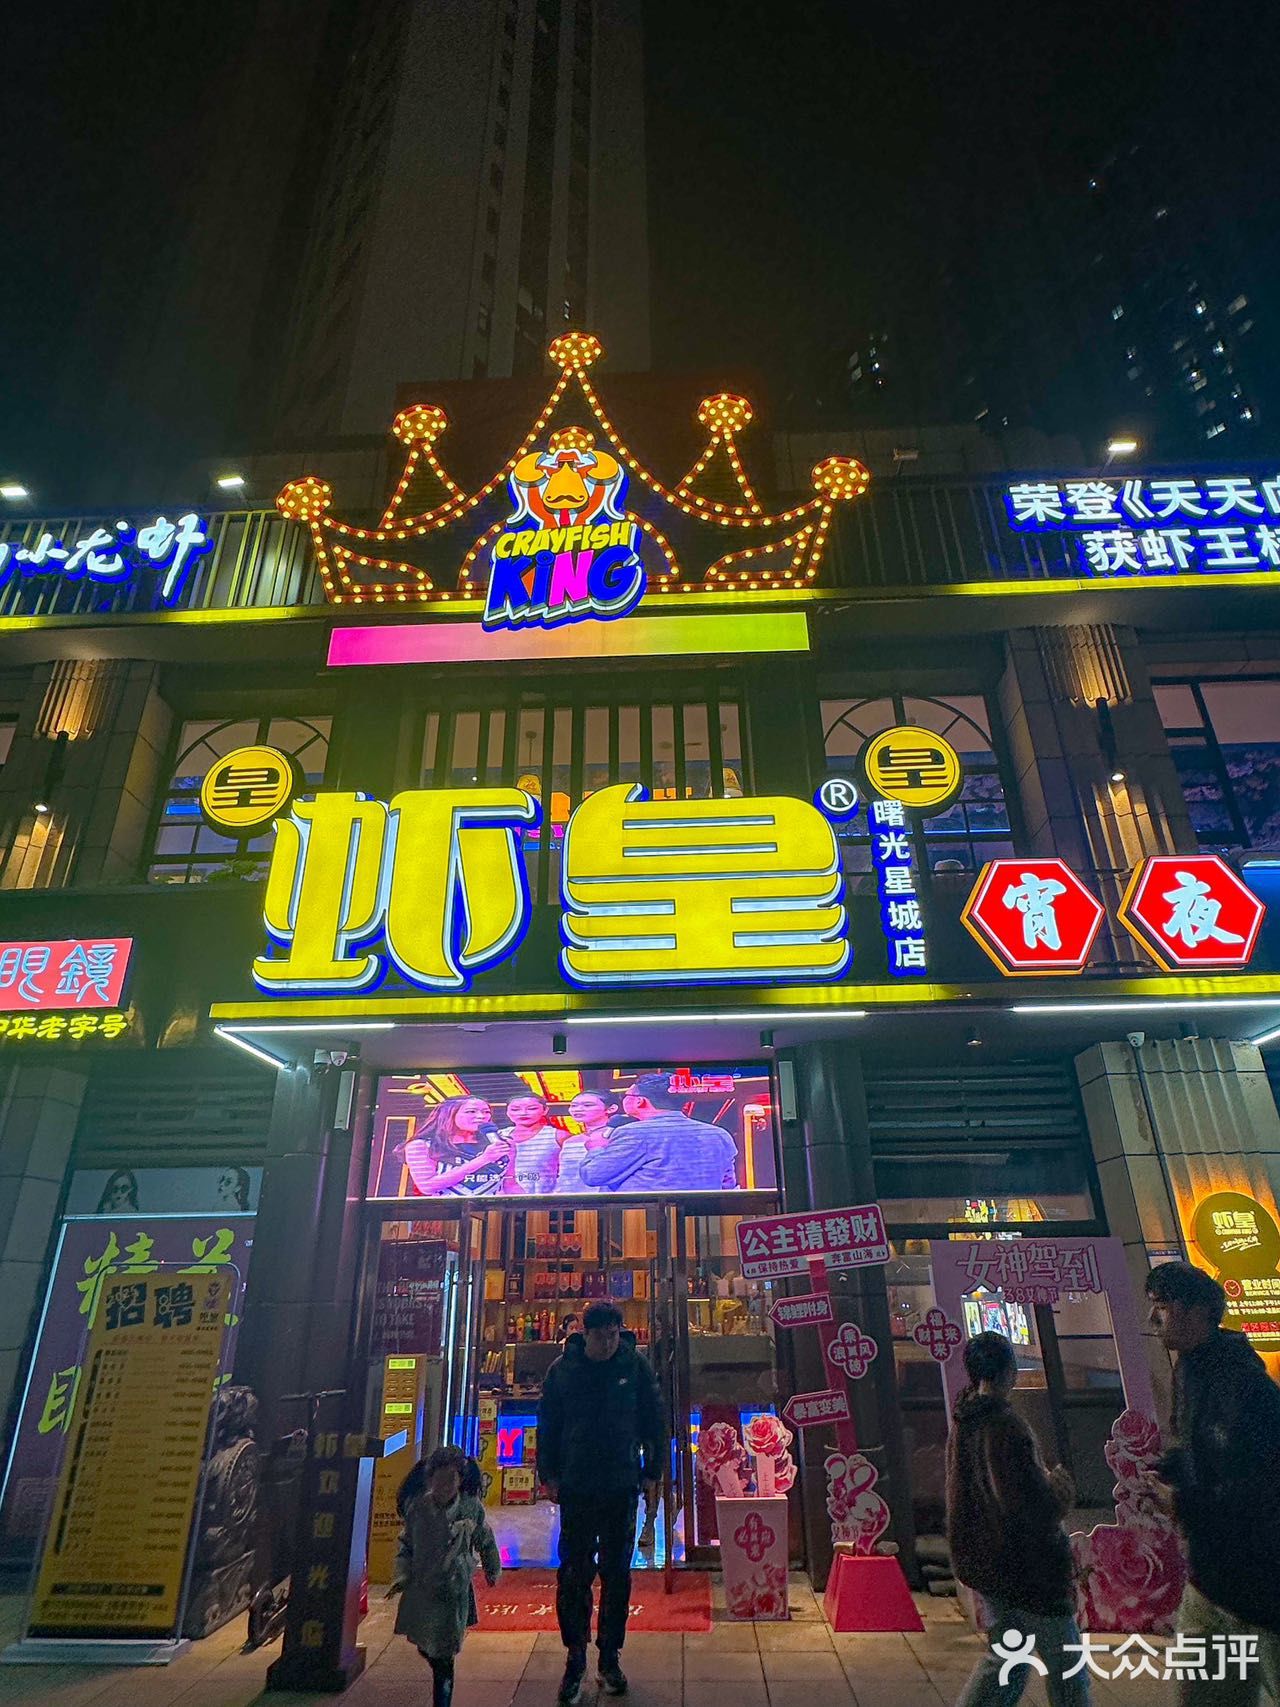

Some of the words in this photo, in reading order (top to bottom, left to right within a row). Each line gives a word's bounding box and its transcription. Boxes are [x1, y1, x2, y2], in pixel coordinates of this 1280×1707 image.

[0, 513, 205, 598] 小龙虾
[495, 521, 632, 560] CRAYFISH
[252, 783, 851, 991] 虾皇
[873, 799, 926, 970] 曙光星城店
[743, 1212, 879, 1257] 公主请發财
[1212, 1210, 1256, 1229] 虾皇
[957, 1243, 1102, 1293] 女神驾到
